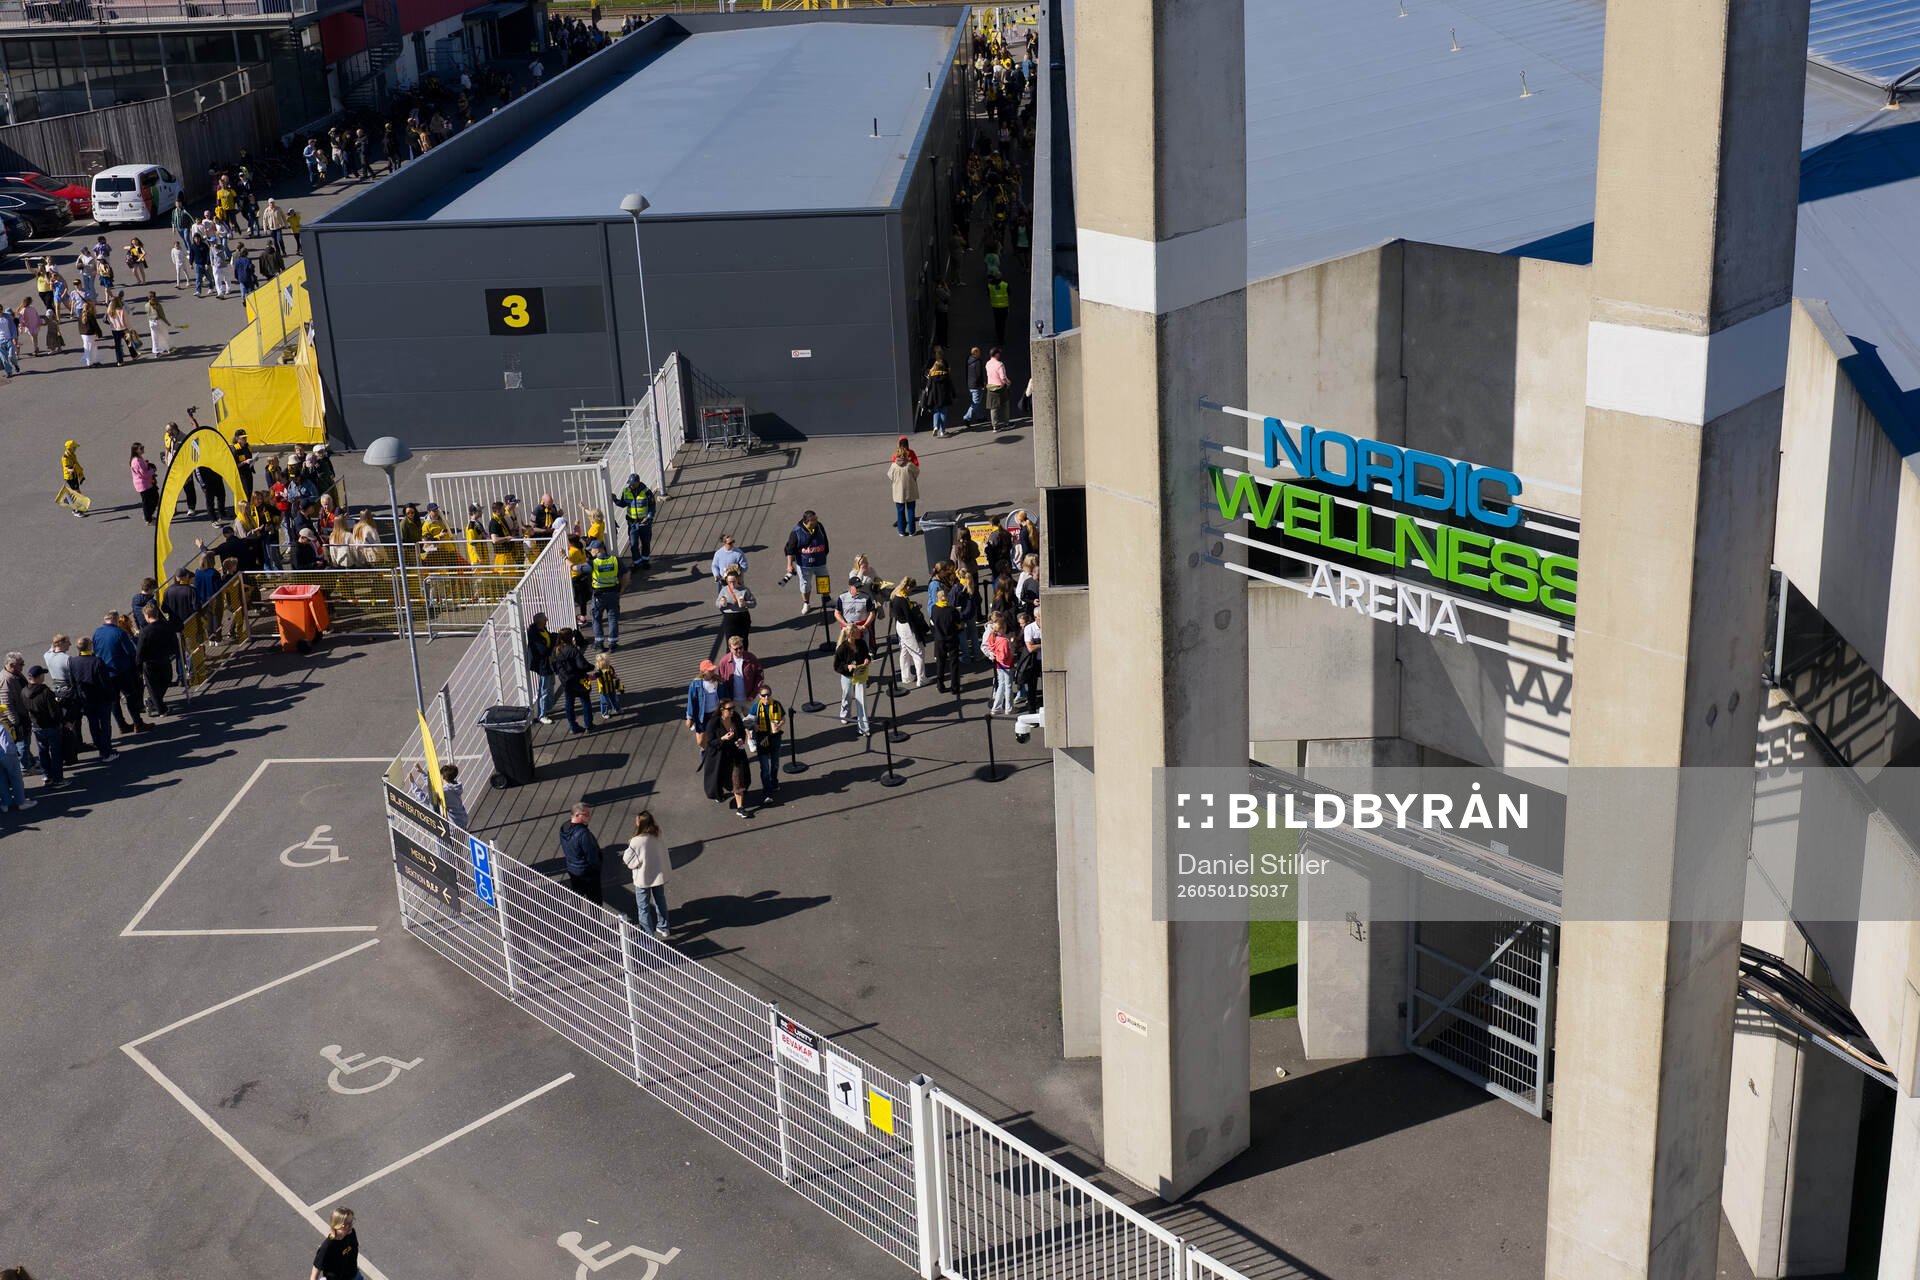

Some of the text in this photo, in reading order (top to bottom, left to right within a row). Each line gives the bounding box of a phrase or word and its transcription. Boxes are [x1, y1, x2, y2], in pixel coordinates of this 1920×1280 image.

[501, 294, 530, 328] 3
[1263, 416, 1523, 528] NORDIC
[1207, 464, 1578, 617] WELLNESS
[1306, 562, 1467, 644] ARENA
[474, 842, 486, 867] P
